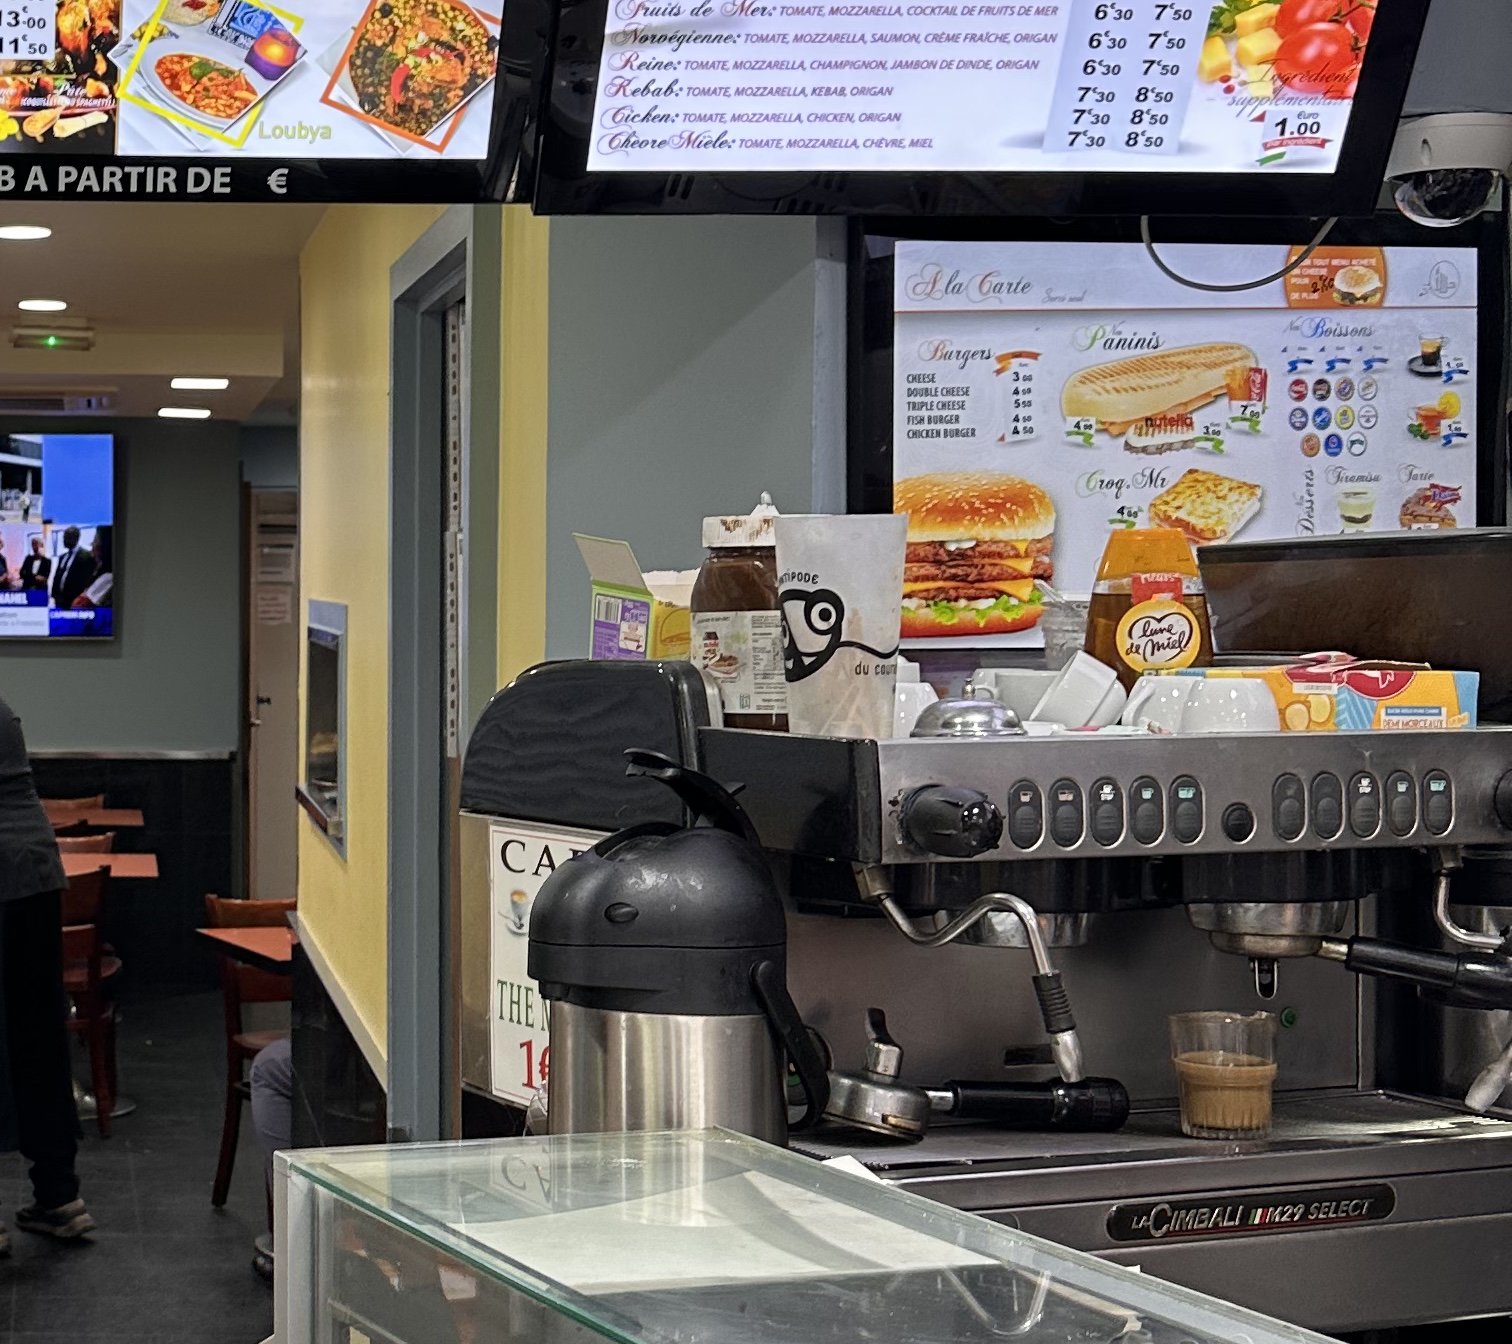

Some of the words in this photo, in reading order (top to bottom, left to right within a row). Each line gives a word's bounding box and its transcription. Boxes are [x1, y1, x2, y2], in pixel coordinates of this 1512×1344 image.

[608, 51, 682, 72] Reine:
[604, 76, 683, 99] Kebab:
[258, 120, 332, 143] Loubya
[1275, 117, 1320, 136] 1.00
[25, 165, 48, 191] A
[58, 165, 178, 193] PARTIR
[187, 166, 232, 193] DE
[267, 168, 288, 194] €
[966, 271, 1034, 304] Carte
[1074, 323, 1165, 352] Paninis
[1300, 316, 1375, 338] Boissons
[918, 339, 996, 369] Burgers
[907, 374, 937, 384] CHEESE
[907, 387, 939, 397] DOUBLE
[940, 386, 971, 397] CHEESE
[907, 401, 935, 411] TRIPLE
[937, 400, 966, 410] CHEESE
[907, 415, 925, 425] FISH
[927, 415, 960, 425] BURGER
[907, 428, 941, 438] CHICKEN
[943, 428, 976, 438] BURGER
[855, 661, 869, 675] du
[497, 979, 535, 1028] THE
[1131, 1216, 1148, 1230] LA
[1149, 1203, 1243, 1237] CIMBALI
[1266, 1204, 1305, 1224] M29
[1307, 1199, 1374, 1220] SELECT
